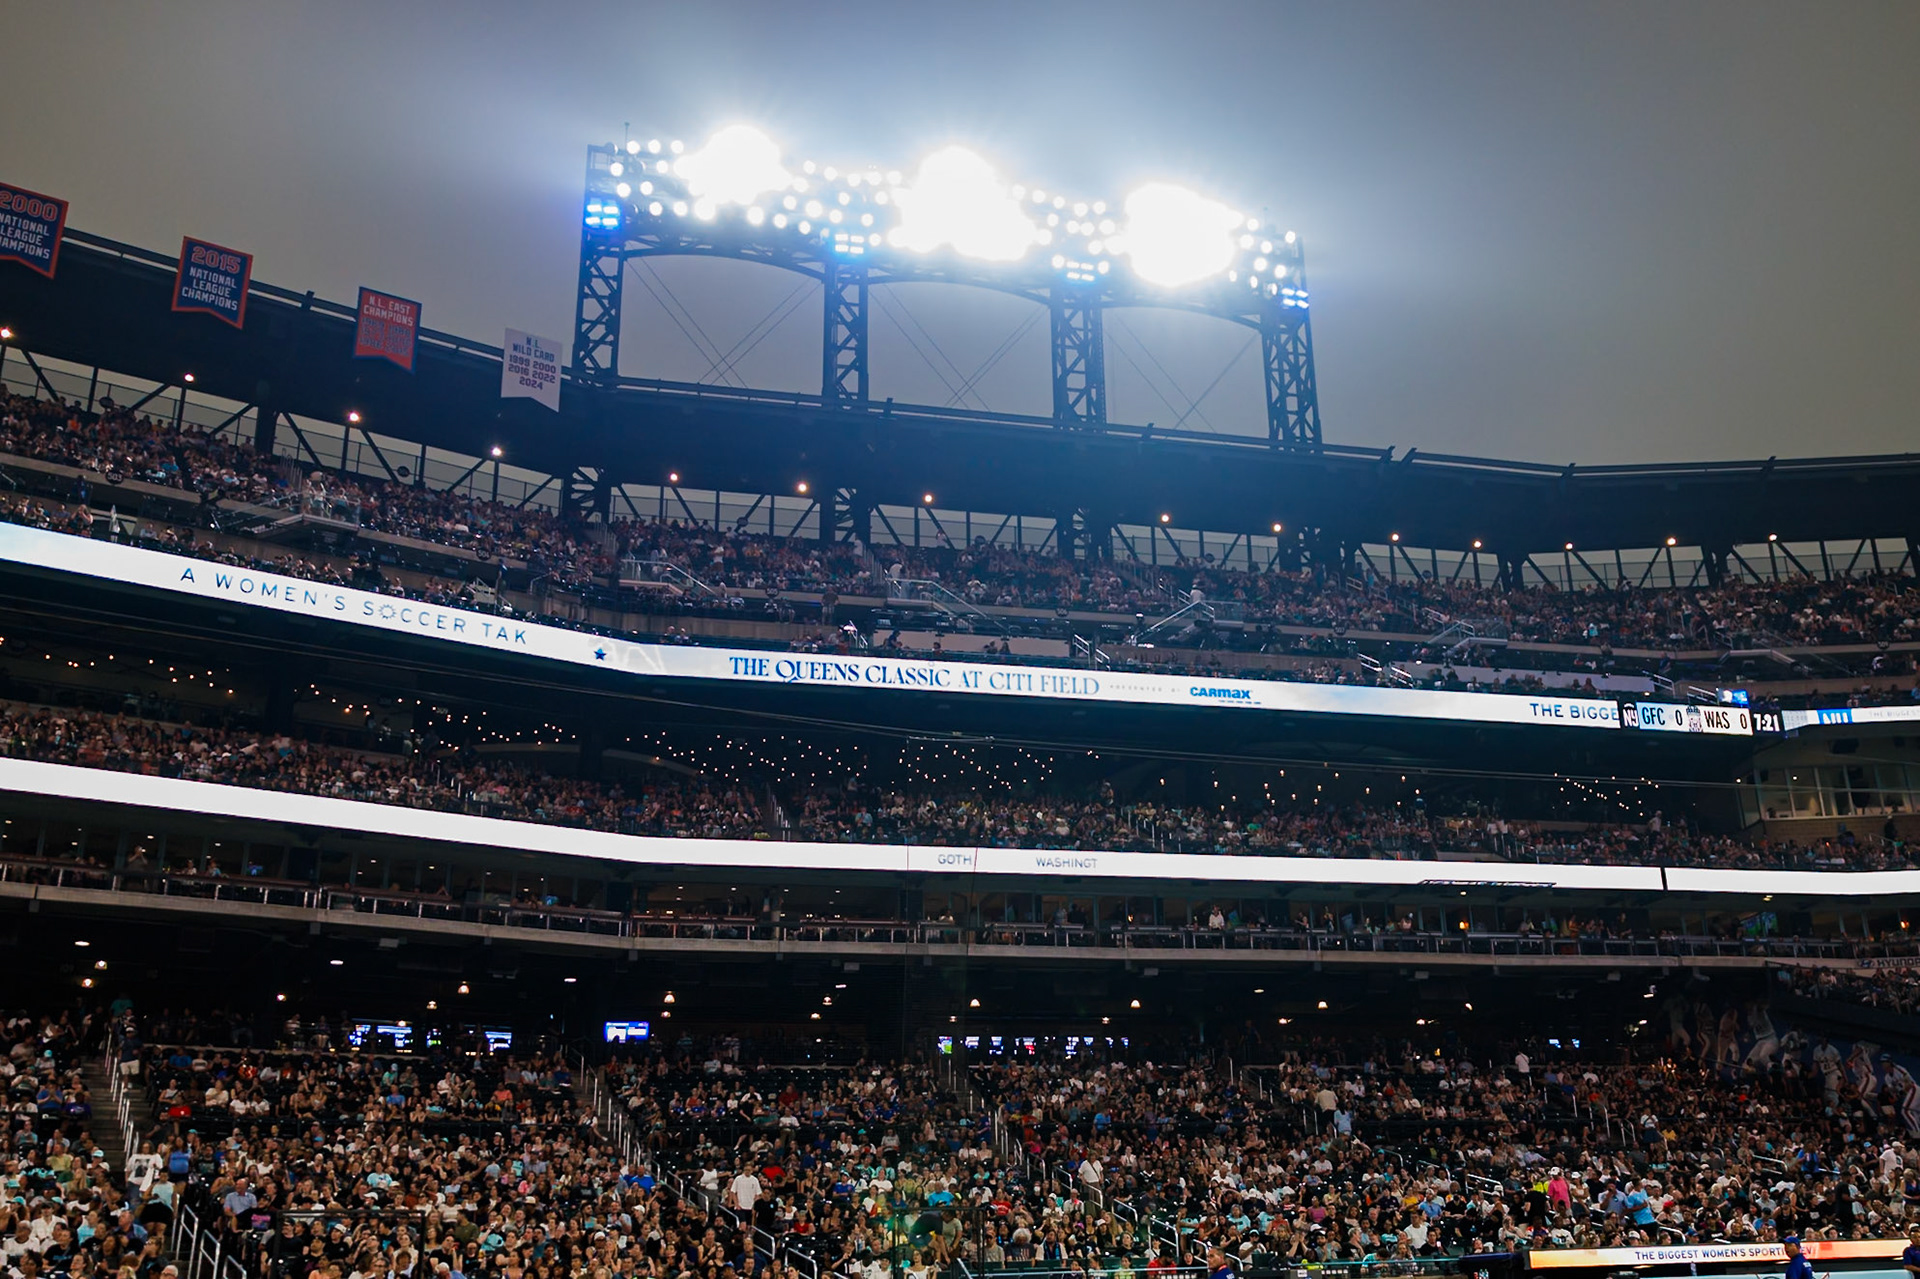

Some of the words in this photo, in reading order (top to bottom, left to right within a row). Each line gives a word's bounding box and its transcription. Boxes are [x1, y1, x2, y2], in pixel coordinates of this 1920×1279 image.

[0, 190, 57, 221] 2000
[0, 225, 44, 246] LEAGUE
[0, 236, 51, 260] AMPIONS
[191, 245, 242, 274] 2015
[189, 266, 238, 289] NATIONAL
[192, 278, 232, 298] LEAGUE
[181, 286, 239, 311] CHAMPIONS
[388, 301, 411, 315] EAST
[363, 304, 414, 327] CHAMPIONS
[512, 343, 532, 356] WILD
[534, 349, 555, 363] CARD
[508, 363, 530, 376] 2016
[532, 370, 556, 384] 2022
[509, 354, 531, 367] 1999
[533, 360, 556, 374] 2000
[519, 376, 543, 390] 2024
[180, 567, 196, 584] A
[215, 572, 346, 611] WOMEN'S
[362, 600, 467, 634] SOCCER
[481, 622, 527, 645] TAK
[729, 656, 770, 677] THE
[775, 659, 860, 683] QUEENS
[865, 663, 951, 687] CLASSIC
[959, 670, 983, 688] AT
[989, 671, 1033, 692] CITI
[1040, 674, 1100, 695] FIELD
[1530, 703, 1564, 719] THE
[1569, 704, 1620, 721] BIGGE
[1642, 707, 1666, 726] GFC
[1675, 709, 1684, 727] 0
[1703, 710, 1731, 730] WAS
[1740, 713, 1748, 730] 0
[1753, 713, 1781, 732] 7:21
[937, 854, 973, 866] GOTH
[1035, 857, 1098, 869] WASHINGT
[1635, 1251, 1655, 1261] THE
[1657, 1249, 1699, 1260] BIGGEST
[1701, 1248, 1747, 1259] WOMEN'S
[1749, 1246, 1786, 1258] SPORTI
